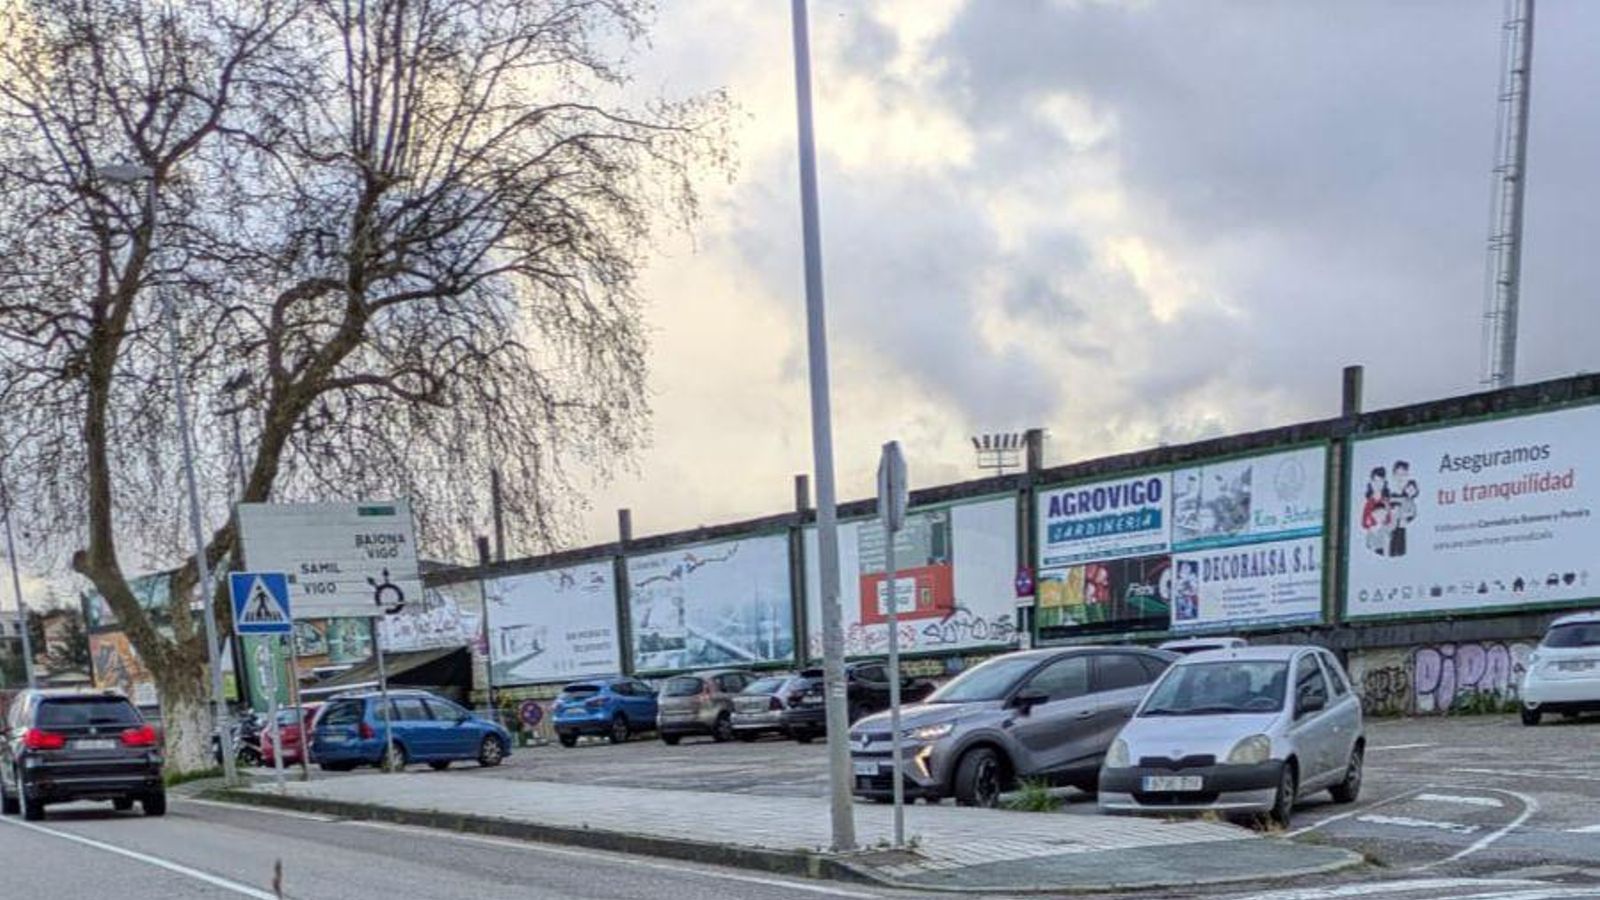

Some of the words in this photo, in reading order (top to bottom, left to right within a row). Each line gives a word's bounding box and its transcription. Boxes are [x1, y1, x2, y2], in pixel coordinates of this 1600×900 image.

[1439, 444, 1550, 474] Aseguramos
[1048, 477, 1163, 519] AGROVIGO
[1437, 489, 1456, 505] tu
[1462, 468, 1574, 501] tranquilidad
[366, 546, 398, 559] VIGO
[1202, 549, 1286, 582] DECORALSA
[300, 562, 342, 575] SAMIL
[303, 581, 337, 595] VIGO
